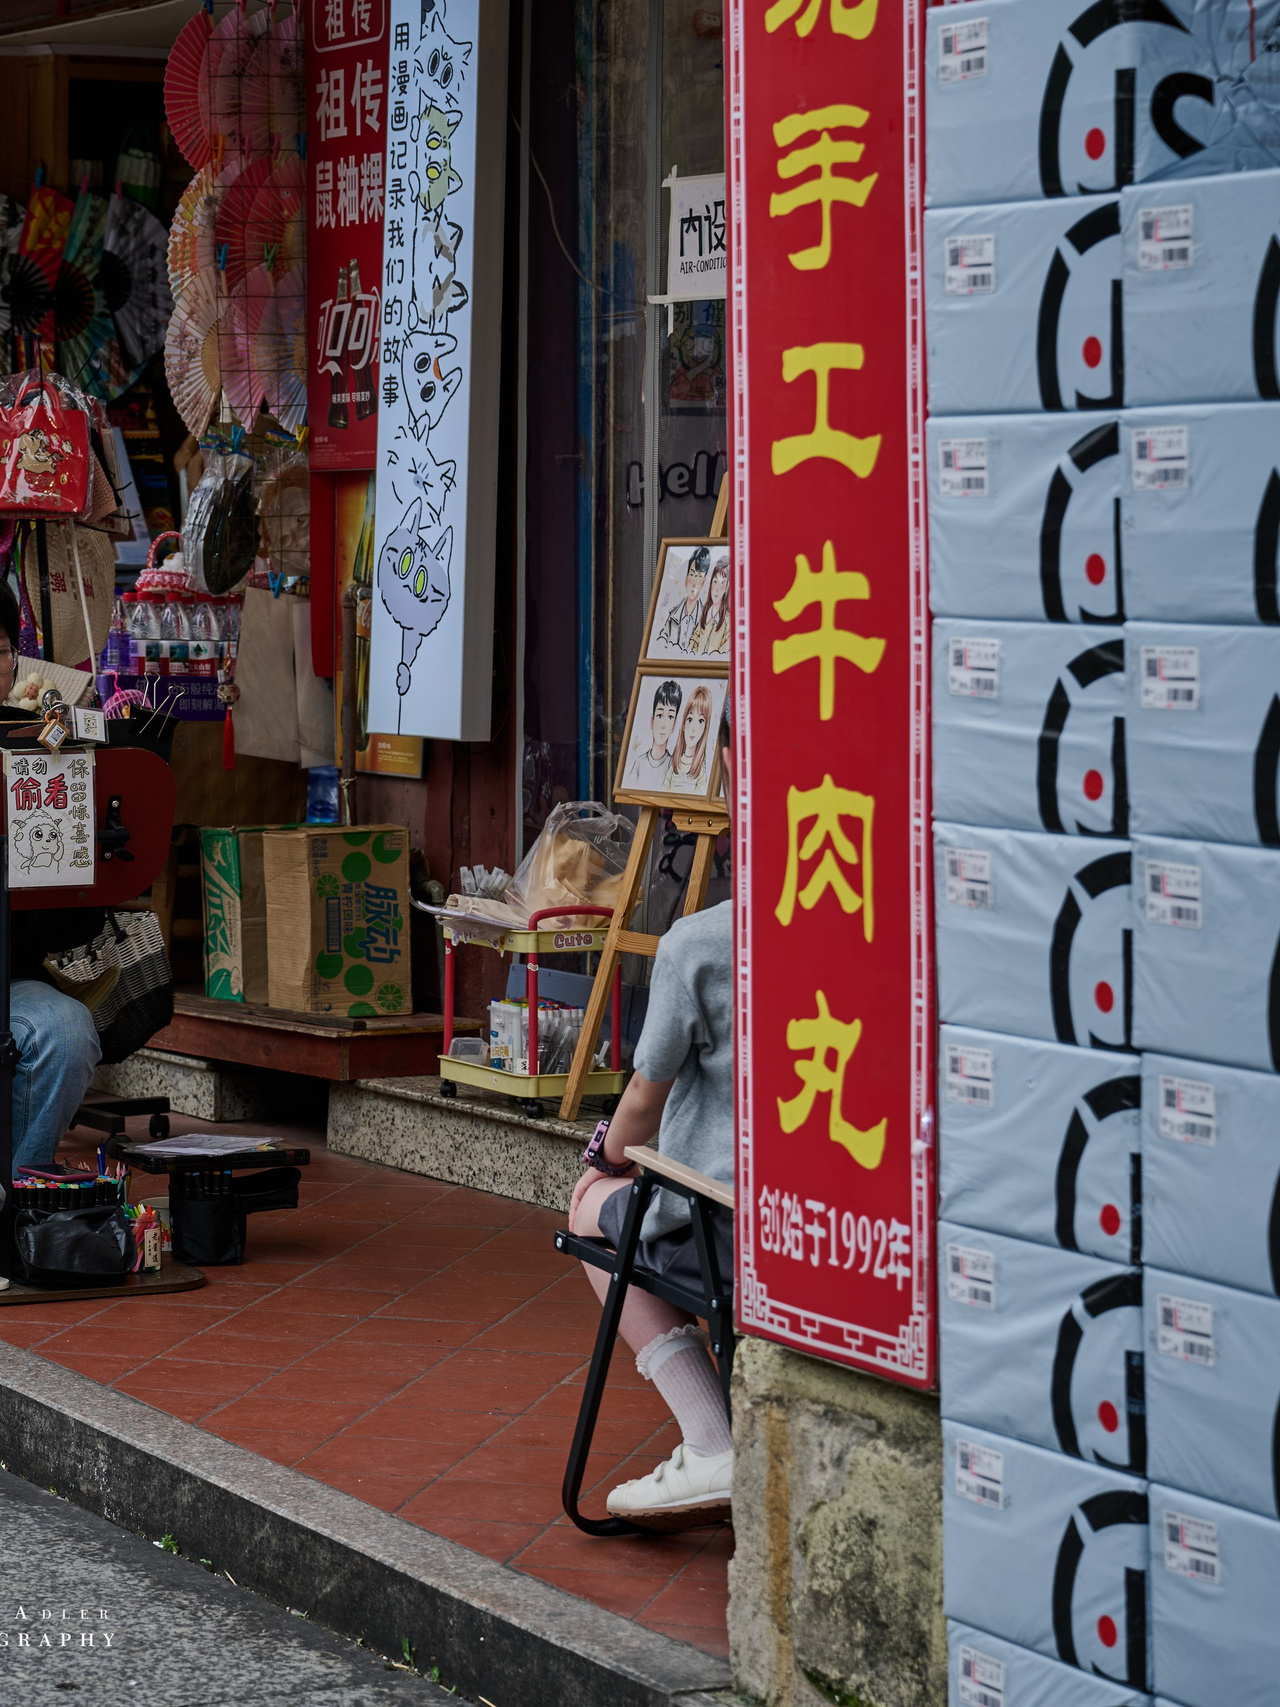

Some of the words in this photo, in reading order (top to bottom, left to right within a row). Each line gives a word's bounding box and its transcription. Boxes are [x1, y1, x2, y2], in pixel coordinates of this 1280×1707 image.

[315, 59, 384, 142] 祖传
[381, 22, 411, 408] 用漫画记录我们的故事
[10, 772, 69, 811] 偷看
[11, 757, 48, 776] 请勿
[341, 882, 354, 936] 青柠口味
[357, 881, 402, 965] 脉动
[553, 932, 594, 949] Cute
[758, 1183, 912, 1291] 创始于1992年
